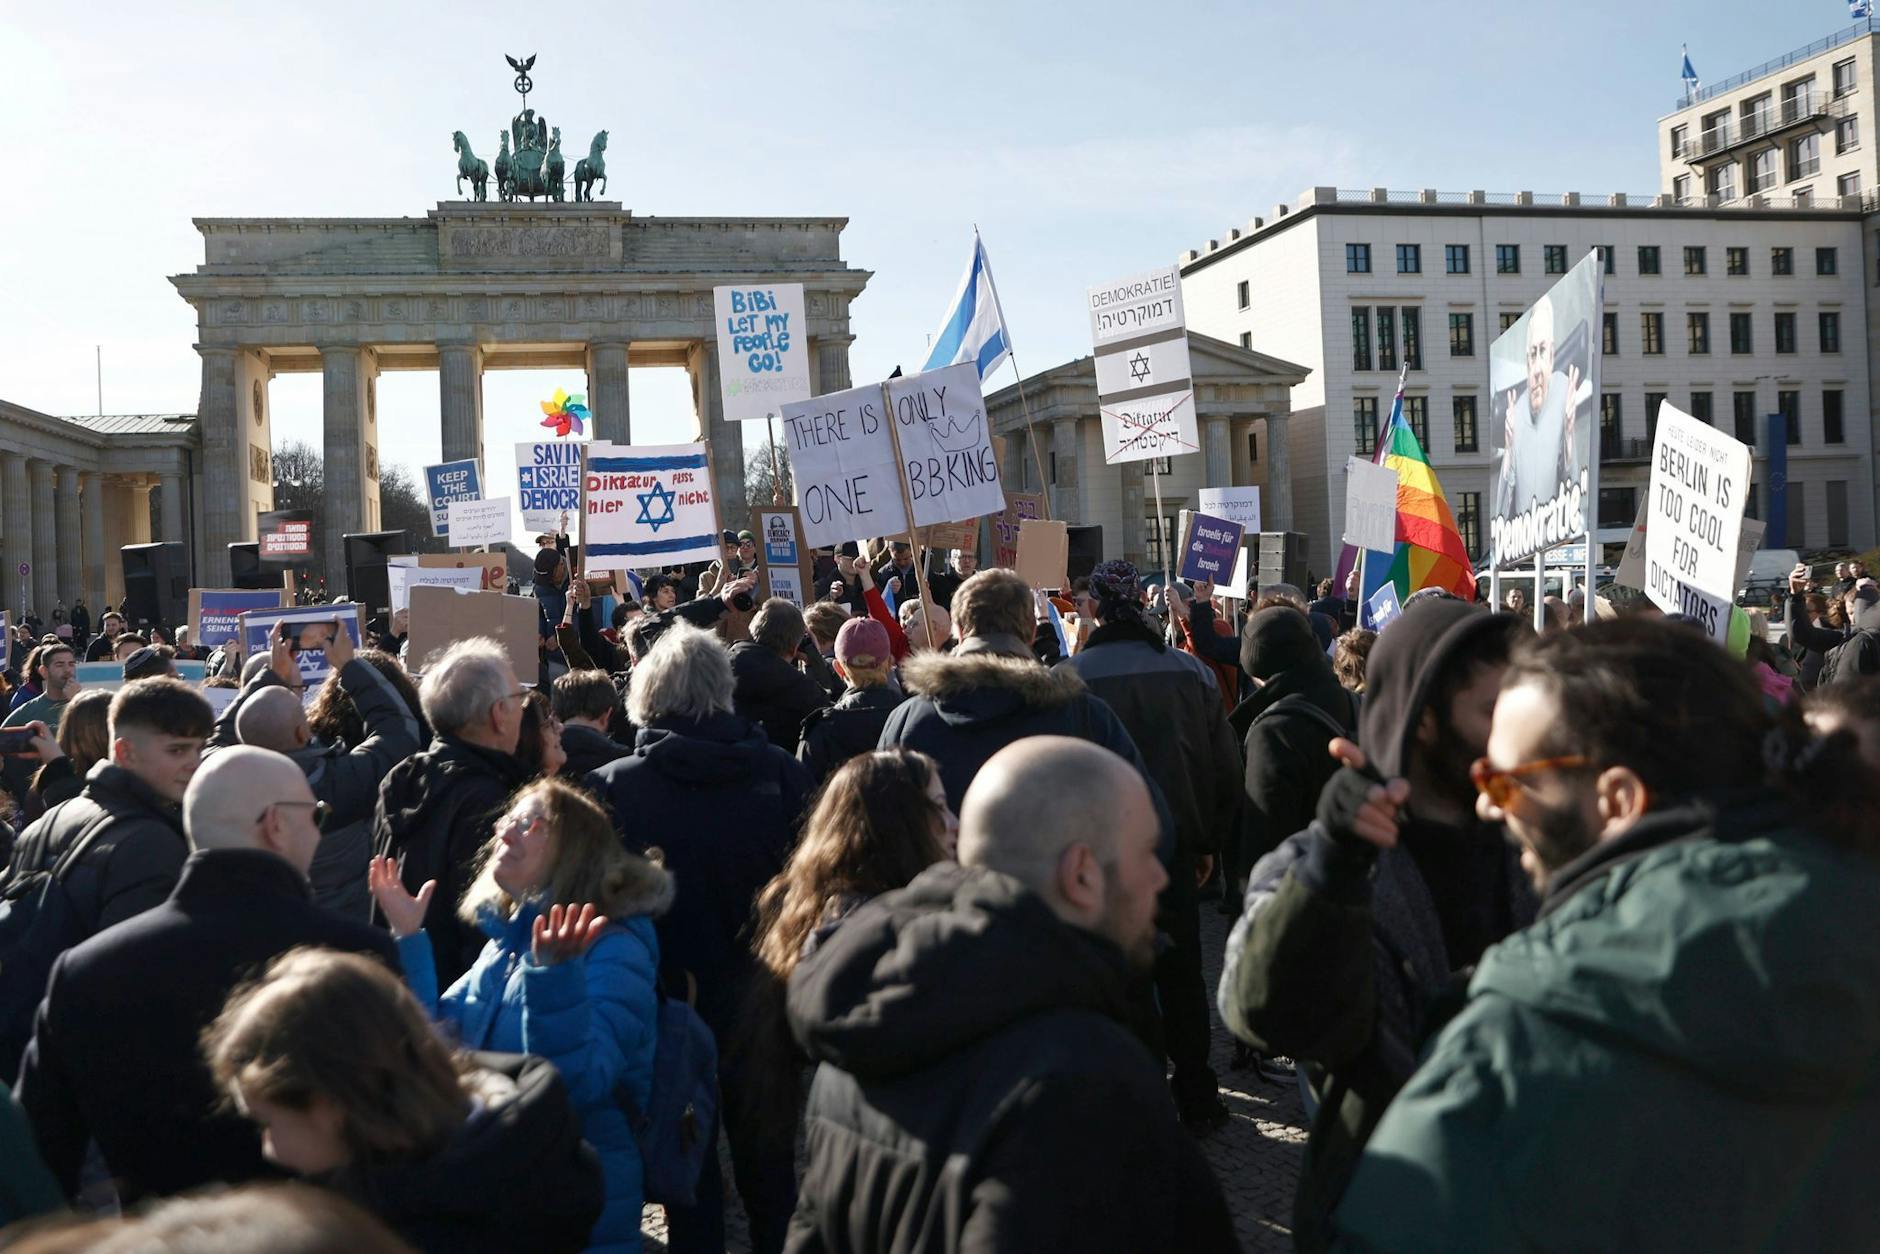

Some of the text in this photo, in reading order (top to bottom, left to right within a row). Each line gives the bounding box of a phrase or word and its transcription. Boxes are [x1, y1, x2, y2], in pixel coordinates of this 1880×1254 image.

[1092, 272, 1175, 308] DEMOKRATIE!
[765, 313, 789, 335] MY
[1097, 298, 1173, 331] דמוקרטיה!
[748, 351, 783, 374] GO!
[784, 386, 947, 450] THERE IS ONLY
[1120, 409, 1173, 429] Diktatur
[533, 443, 581, 465] SAVIN
[1710, 446, 1728, 464] NICHT
[437, 470, 468, 484] KEEP
[531, 467, 579, 488] ISRAE
[587, 474, 656, 492] Diktatur
[1660, 443, 1731, 508] BERLIN IS
[441, 482, 468, 495] THE
[521, 488, 579, 510] DEMOCR
[679, 489, 710, 506] nicht
[434, 491, 478, 508] COURT
[805, 475, 873, 524] ONE
[1659, 483, 1683, 524] TOO
[1689, 503, 1724, 552] COOL
[1192, 540, 1204, 552] die
[1221, 531, 1234, 545] für
[1197, 557, 1220, 571] Israels
[1672, 535, 1698, 579] FOR
[1651, 560, 1718, 637] DICTATORS
[206, 624, 233, 633] SEINE
